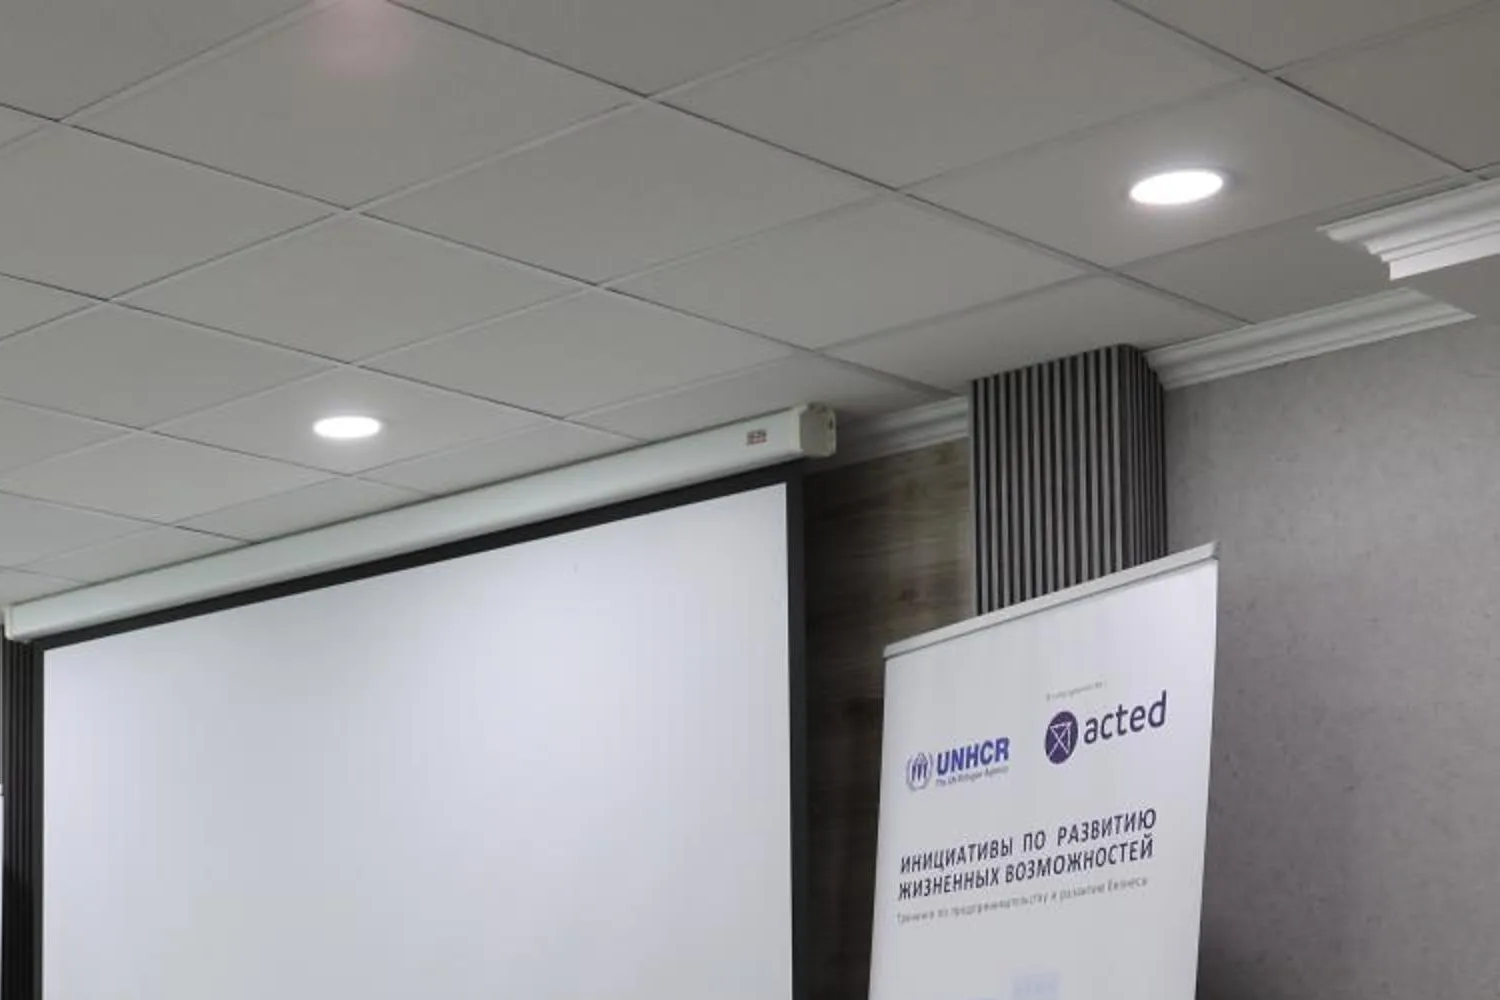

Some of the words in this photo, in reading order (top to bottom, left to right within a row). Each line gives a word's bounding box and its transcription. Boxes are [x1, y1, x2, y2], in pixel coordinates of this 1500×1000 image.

[1083, 690, 1167, 746] acted
[936, 737, 1010, 776] UNHCR
[897, 867, 1000, 901] ЖИЗНЕННЫХ
[1005, 834, 1154, 883] ВОЗМОЖНОСТЕЙ
[900, 837, 1013, 874] ИНИЦИАТИВЫ
[1022, 830, 1046, 853] ПО
[1057, 808, 1157, 847] РАЗВИТИЮ
